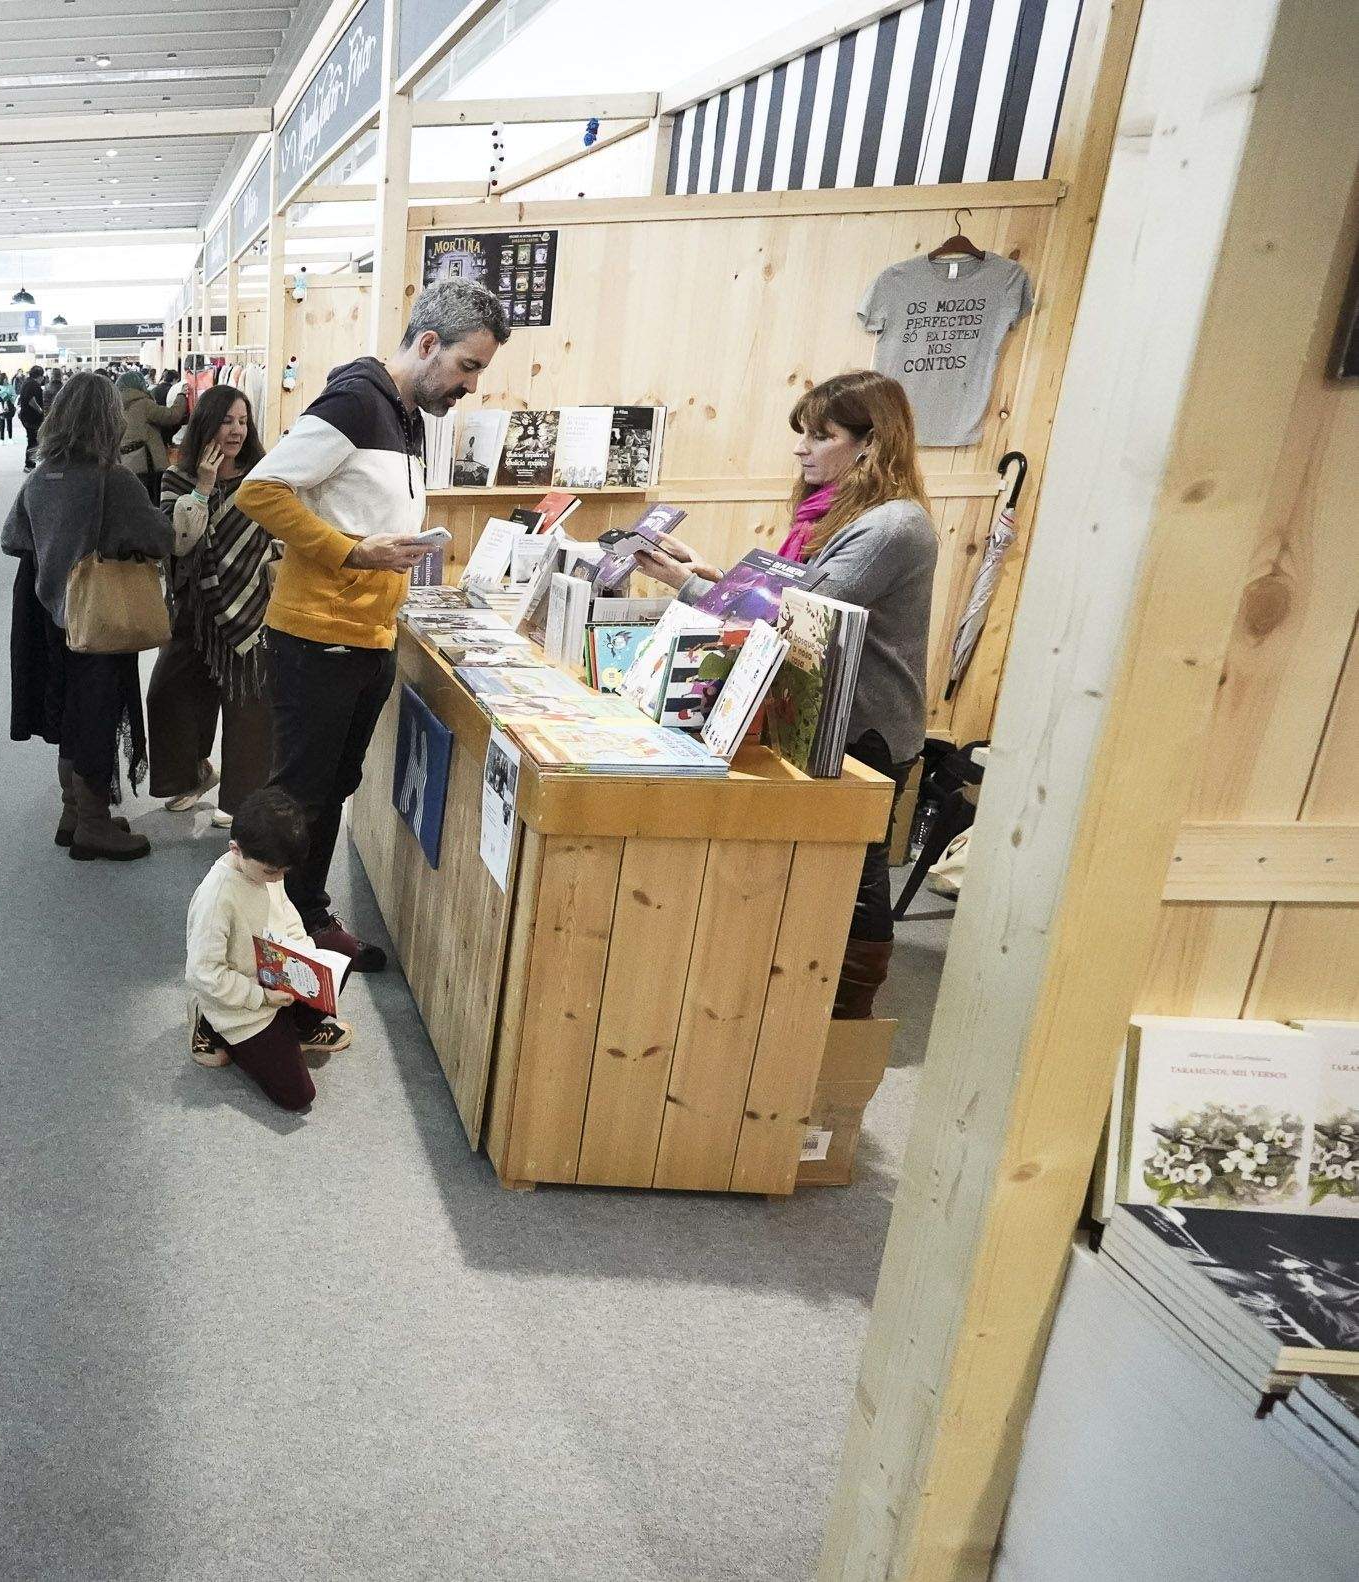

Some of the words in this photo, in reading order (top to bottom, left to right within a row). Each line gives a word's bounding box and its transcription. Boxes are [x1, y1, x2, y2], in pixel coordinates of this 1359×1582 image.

[906, 301, 927, 315] OS
[936, 298, 986, 313] MOZOS
[905, 314, 984, 330] PERFECTOS
[902, 330, 918, 343] SÓ
[926, 329, 980, 342] EXISTEN
[927, 343, 952, 355] NOS
[903, 355, 967, 373] CONTOS
